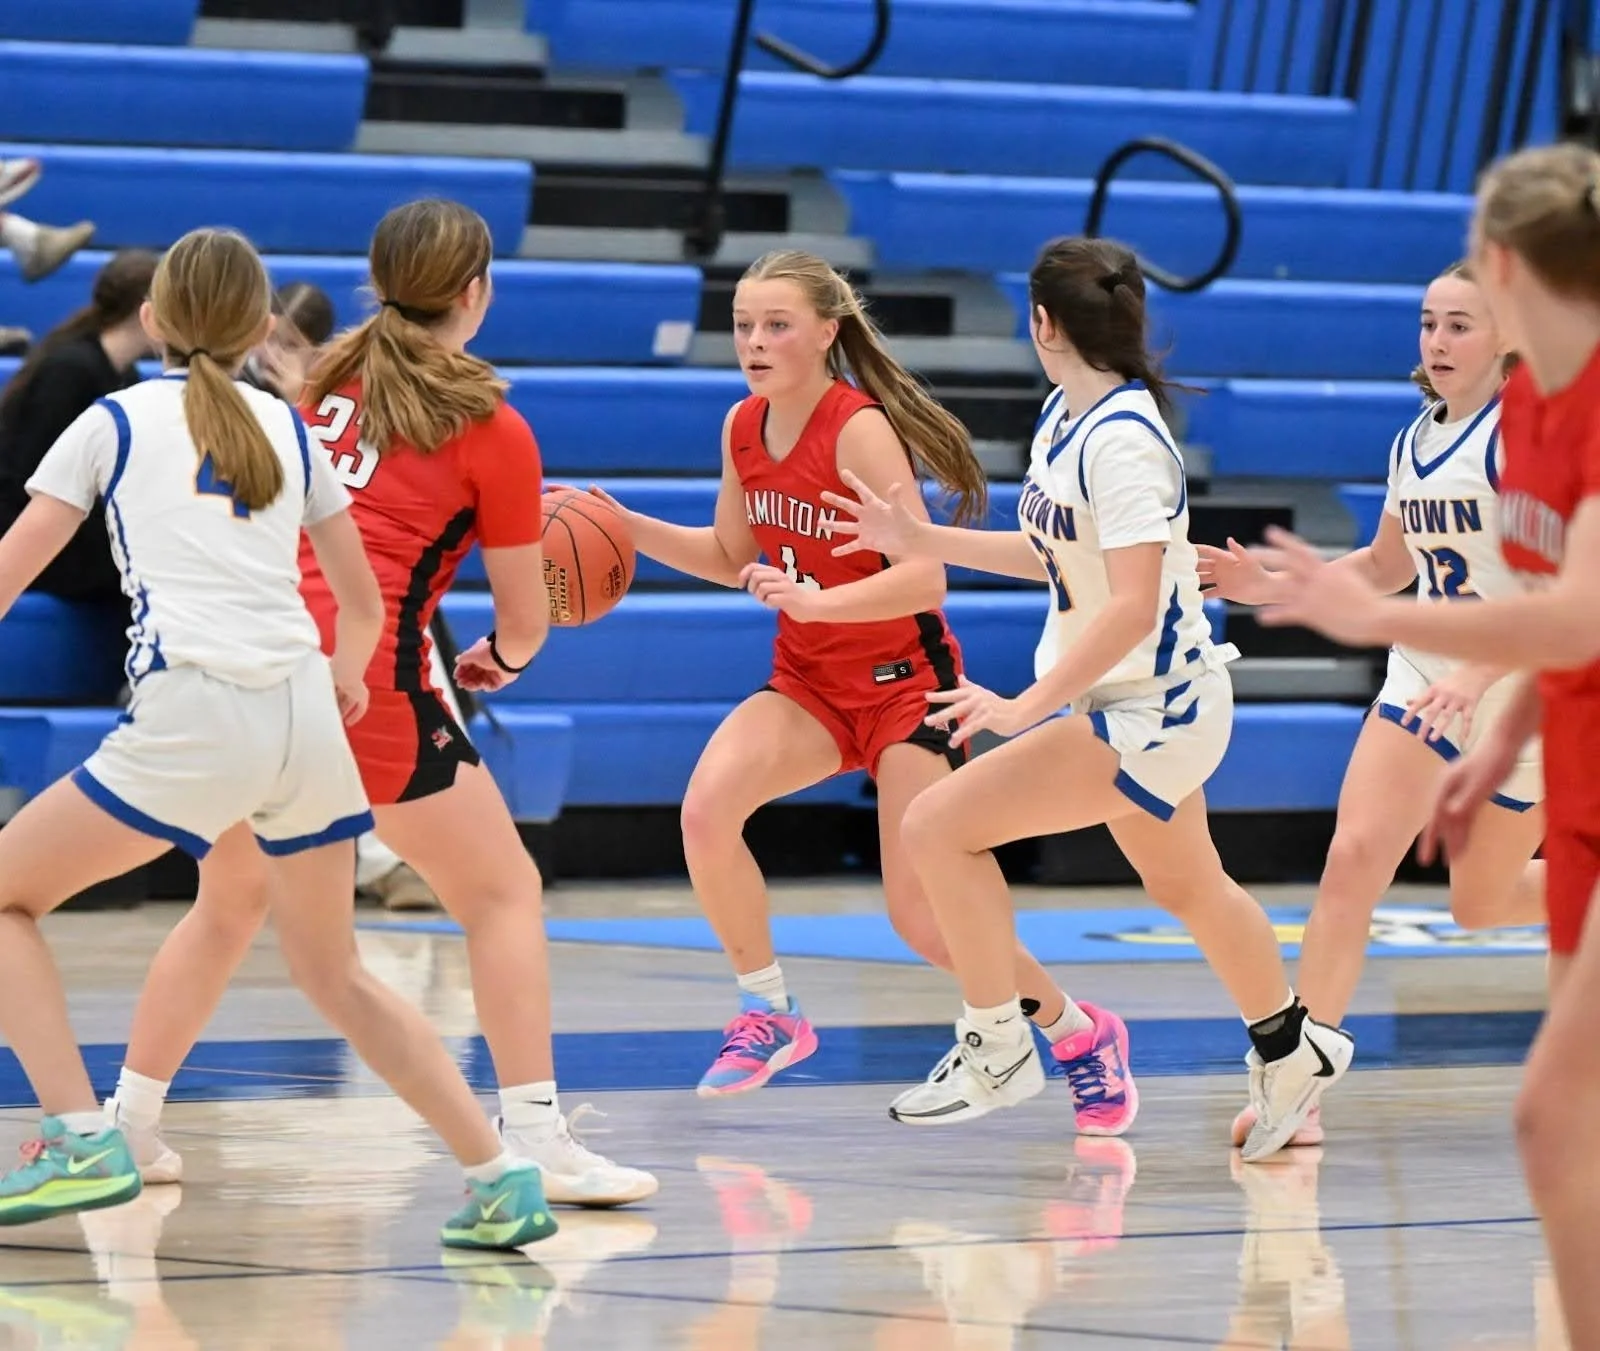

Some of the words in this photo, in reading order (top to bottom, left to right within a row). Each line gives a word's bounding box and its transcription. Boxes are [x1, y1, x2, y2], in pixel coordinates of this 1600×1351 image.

[309, 393, 380, 489] 23
[1020, 476, 1077, 541] TOWN
[1399, 499, 1483, 534] TOWN
[1416, 546, 1483, 601] 12
[899, 666, 907, 674] S
